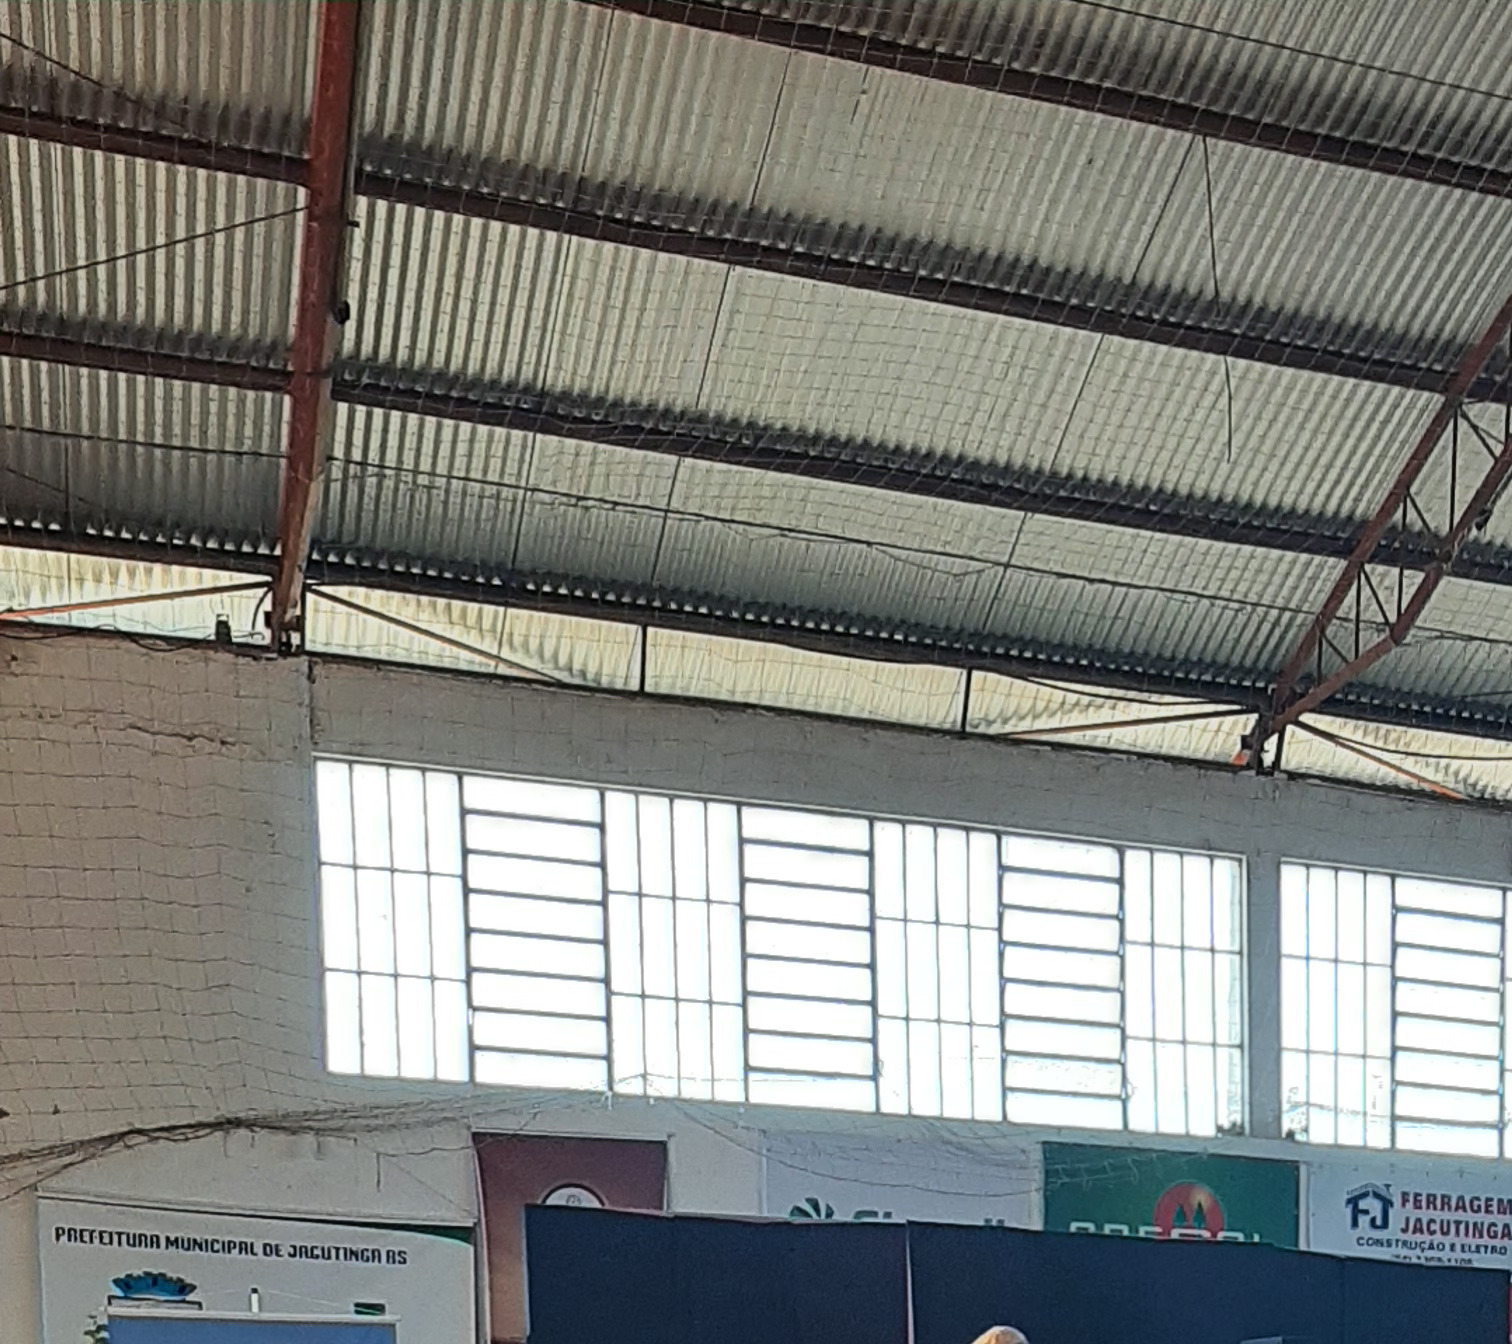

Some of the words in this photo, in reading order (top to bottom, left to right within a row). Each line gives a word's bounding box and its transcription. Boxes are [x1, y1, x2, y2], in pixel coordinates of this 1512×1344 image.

[54, 1226, 161, 1250] PREFEITURA
[165, 1233, 259, 1257] MUNICIPAL
[262, 1242, 286, 1258] DE
[287, 1244, 382, 1264] JACUTINGA
[1356, 1236, 1446, 1253] CONSTRUÇÃO
[1449, 1242, 1457, 1252] E
[1460, 1242, 1508, 1256] ELETRO
